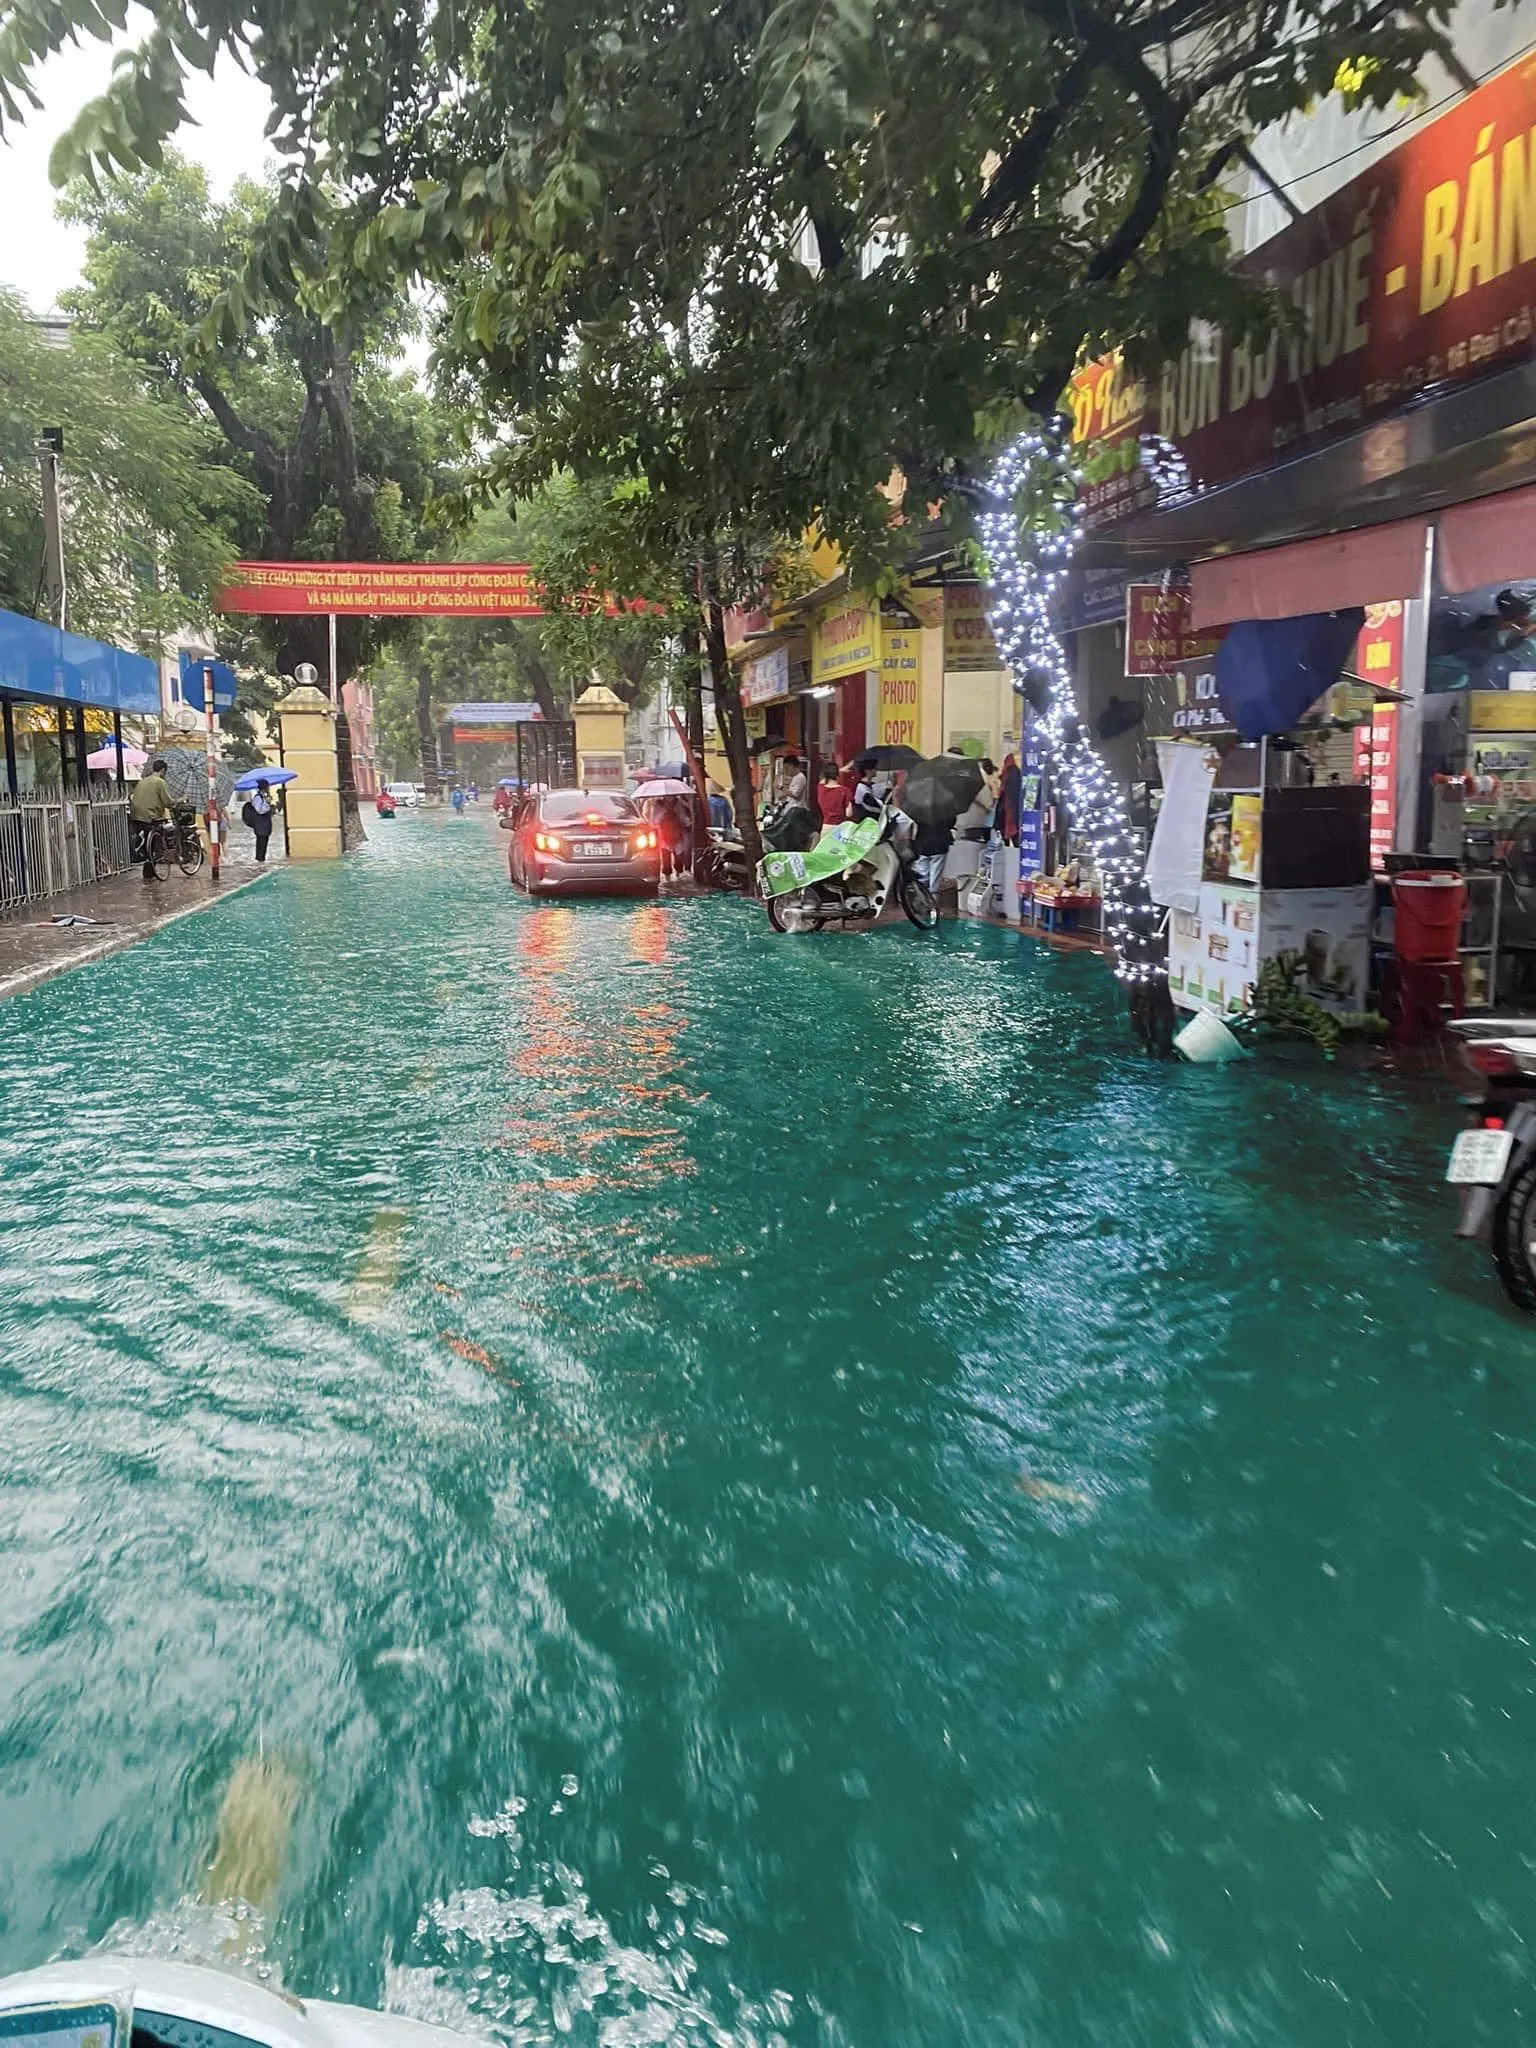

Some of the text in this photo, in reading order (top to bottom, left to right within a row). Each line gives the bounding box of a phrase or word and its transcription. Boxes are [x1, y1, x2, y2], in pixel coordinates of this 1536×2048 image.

[420, 571, 450, 587] THÀNH
[469, 572, 494, 588] CÔNG
[494, 572, 520, 588] ĐOÀN
[380, 590, 411, 607] THÀNH
[429, 591, 454, 607] CÔNG
[455, 591, 480, 607] ĐOÀN
[480, 591, 500, 610] VIỆT
[500, 593, 522, 608] NAM
[882, 679, 917, 705] PHOTO
[884, 719, 915, 745] COPY
